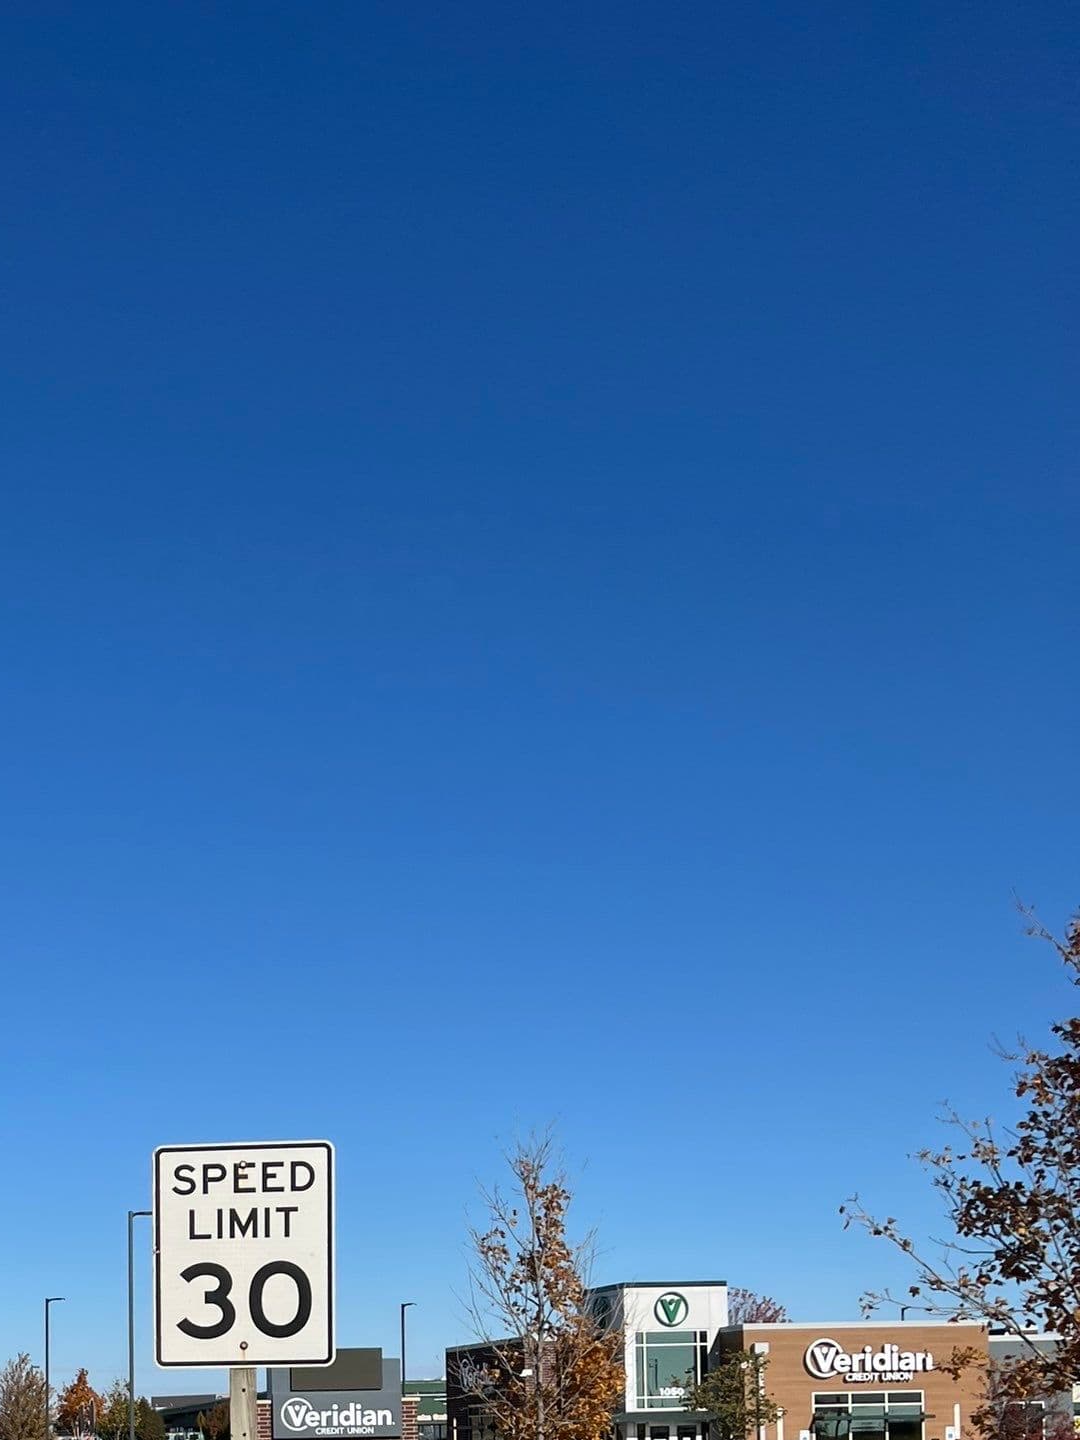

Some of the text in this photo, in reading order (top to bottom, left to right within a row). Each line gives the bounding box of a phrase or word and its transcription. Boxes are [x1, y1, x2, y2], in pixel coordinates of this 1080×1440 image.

[172, 1161, 315, 1195] SPEED
[188, 1206, 299, 1240] LIMIT
[176, 1260, 312, 1340] 30
[808, 1340, 933, 1375] Veridian
[845, 1371, 913, 1382] CREDIT UNION
[283, 1400, 393, 1429] Veridian
[315, 1426, 375, 1435] CREDIT UNION
